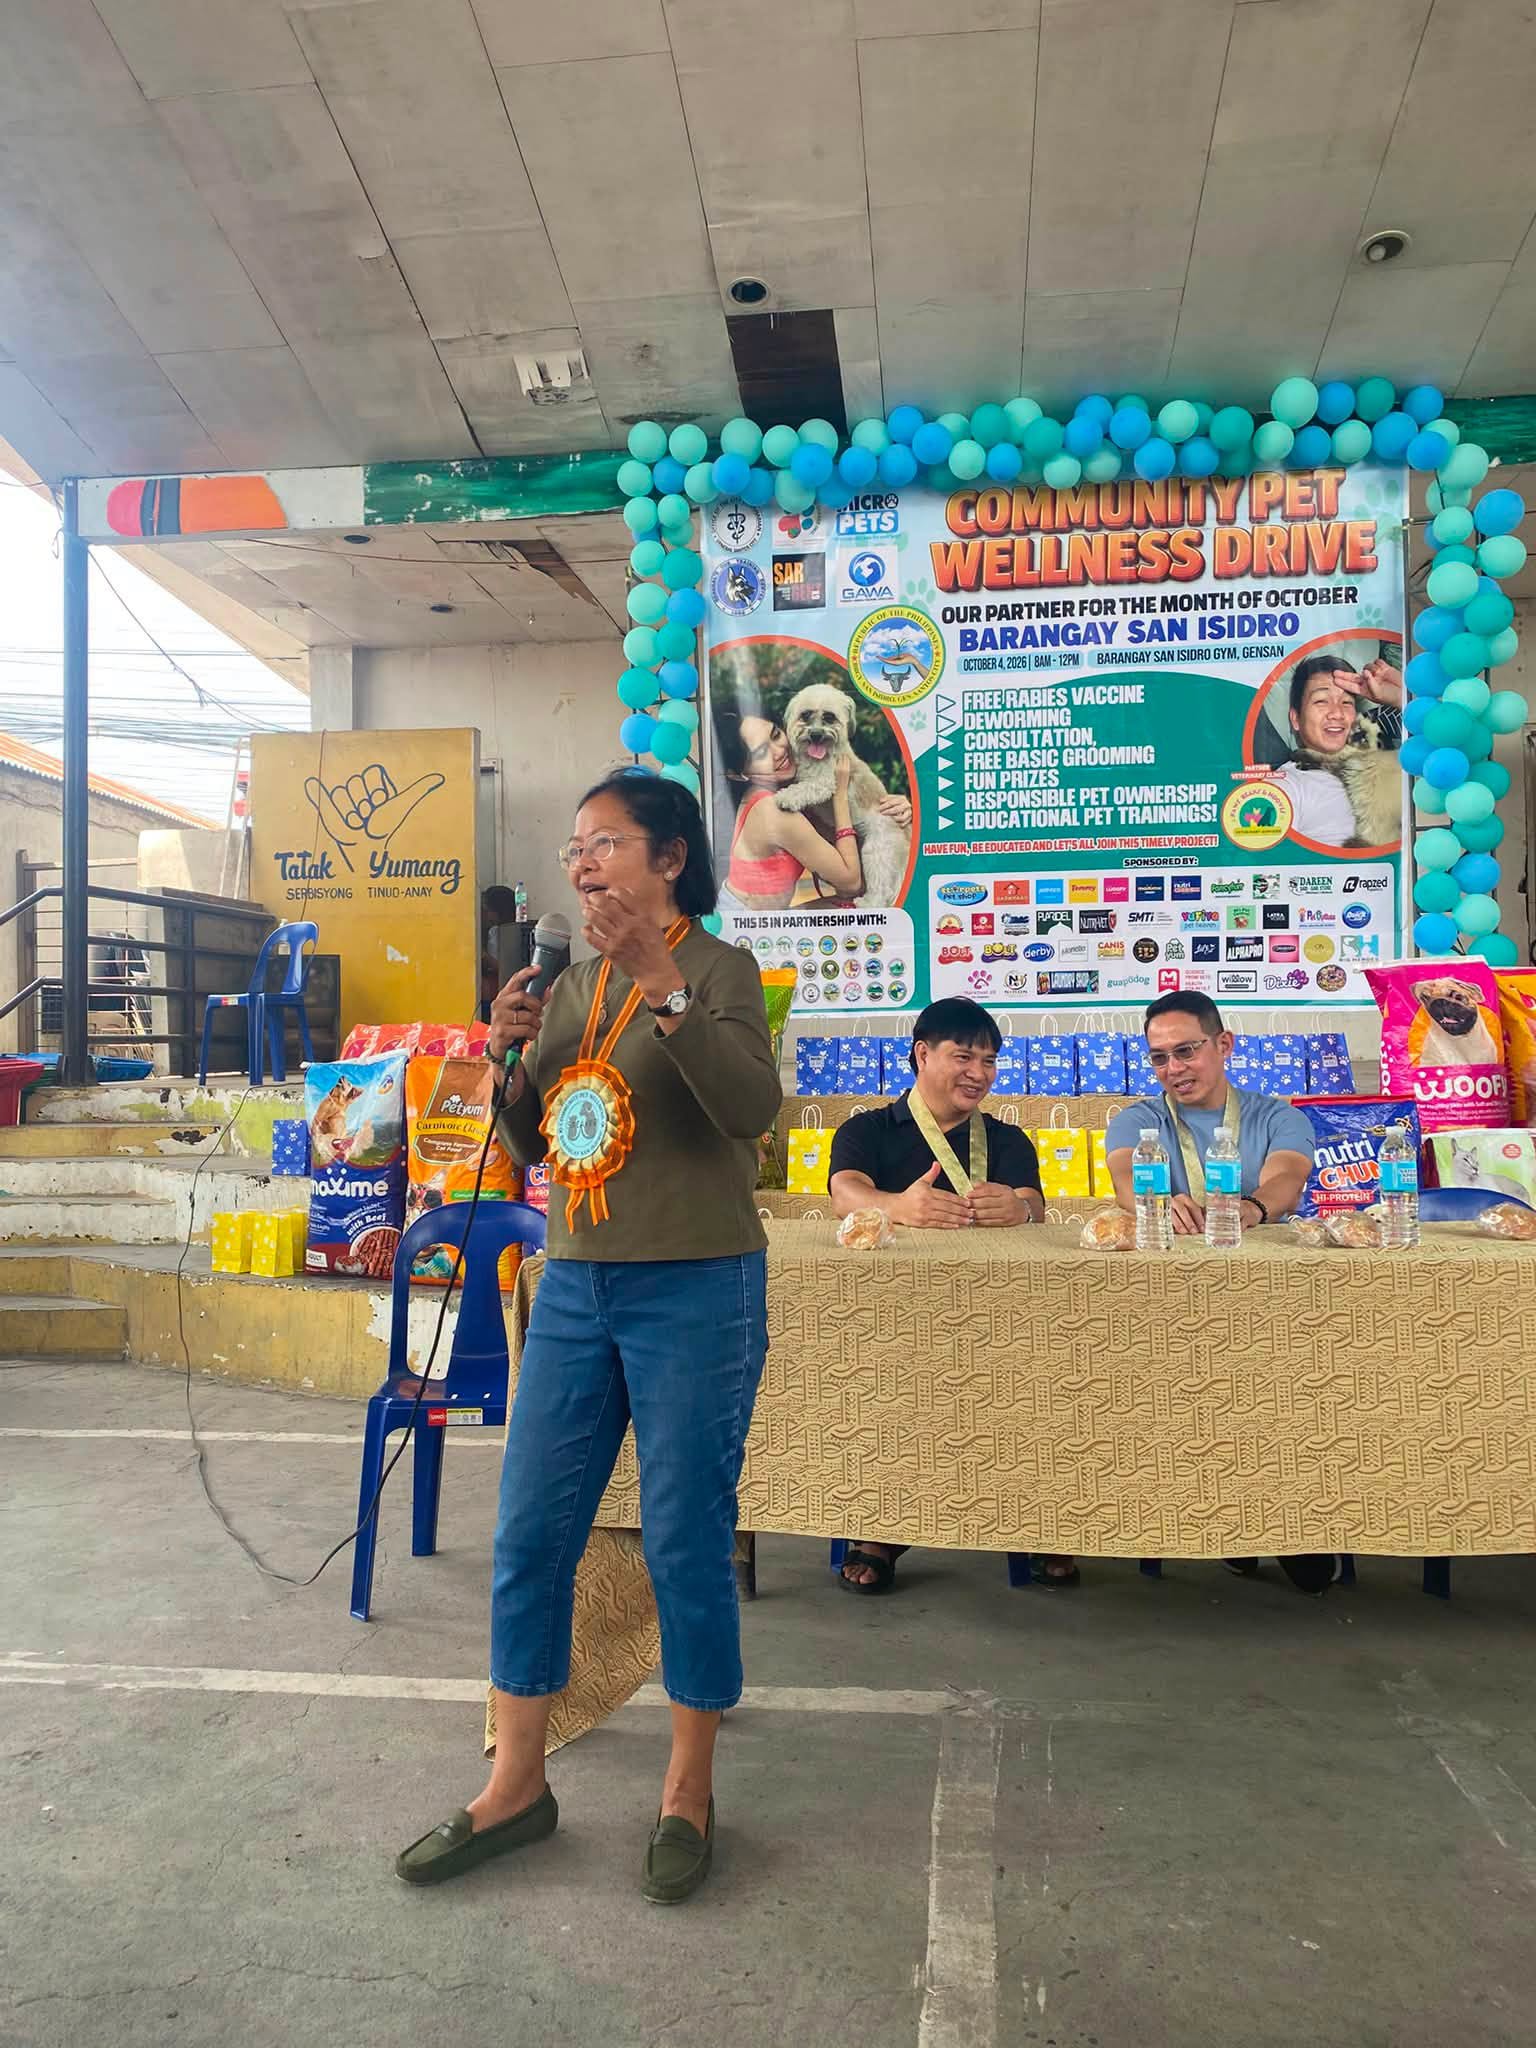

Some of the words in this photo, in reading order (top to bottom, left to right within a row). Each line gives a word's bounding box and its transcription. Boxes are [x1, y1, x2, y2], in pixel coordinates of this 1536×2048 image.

[945, 476, 1245, 537] COMMUNITY
[1249, 467, 1346, 522] PET
[839, 512, 896, 534] PETS
[929, 528, 1205, 592] WELLNESS
[1213, 520, 1378, 579] DRIVE
[842, 586, 893, 599] GAWA
[941, 605, 982, 624] OUR
[985, 600, 1075, 623] PARTNER
[1079, 598, 1116, 616] FOR
[1119, 594, 1156, 615] THE
[1160, 591, 1234, 613] MONTH
[1237, 590, 1263, 609] OF
[1265, 586, 1358, 607] OCTOBER
[959, 621, 1119, 651] BARANGAY
[1127, 616, 1187, 644] SAN
[1198, 612, 1300, 640] ISIDRO
[963, 657, 997, 672] OCTOBER
[998, 657, 1006, 671] 4,
[1007, 656, 1027, 670] 2026
[1034, 654, 1051, 668] 8AM
[1058, 653, 1079, 667] 12PM
[1097, 651, 1150, 665] BARANGAY
[1154, 649, 1175, 663] SAN
[1177, 648, 1211, 662] ISIDRO
[1213, 647, 1240, 661] GYM,
[1242, 645, 1285, 659] GENSAN
[963, 690, 1002, 710] FREE
[1004, 687, 1068, 709] RABIES
[1071, 685, 1145, 705] VACCINE
[964, 708, 1072, 731] DEWORMING
[964, 727, 1097, 751] CONSULTATION,
[964, 751, 1002, 771] FREE
[1005, 749, 1058, 769] BASIC
[1063, 745, 1155, 767] GROOMING
[964, 771, 997, 790] FUN
[1001, 769, 1060, 789] PRIZES
[964, 788, 1076, 810] RESPONSIBLE
[1080, 787, 1110, 806] PET
[1113, 784, 1217, 805] OWNERSHIP
[964, 808, 1080, 830] EDUCATIONAL
[1084, 807, 1114, 826] PET
[1118, 804, 1217, 825] TRAININGS!
[924, 844, 949, 855] HAVE
[949, 843, 971, 855] FUN,
[972, 843, 985, 853] BE
[985, 841, 1032, 853] EDUCATED
[1032, 840, 1053, 851] AND
[1053, 839, 1078, 851] LET'S
[1079, 838, 1095, 850] ALL
[1097, 838, 1118, 850] JOIN
[1118, 837, 1139, 849] THIS
[1140, 836, 1174, 848] TIMELY
[1174, 835, 1218, 847] PROJECT!
[1124, 858, 1181, 867] SPONSORED
[1182, 856, 1198, 866] BY:
[369, 851, 464, 894] Yumang
[1300, 876, 1333, 886] DAREEN
[286, 887, 353, 901] SERBISYONG
[733, 917, 757, 929] THIS
[758, 917, 769, 928] IS
[770, 917, 781, 928] IN
[782, 915, 856, 928] PARTNERSHIP
[857, 914, 887, 926] WITH:
[984, 943, 1017, 954] BOLT
[1024, 946, 1051, 958] derby
[1098, 941, 1124, 949] CANIS
[441, 1099, 484, 1116] Petyum
[1314, 1133, 1376, 1168] nutri
[1316, 1192, 1371, 1202] HI-PROTEIN
